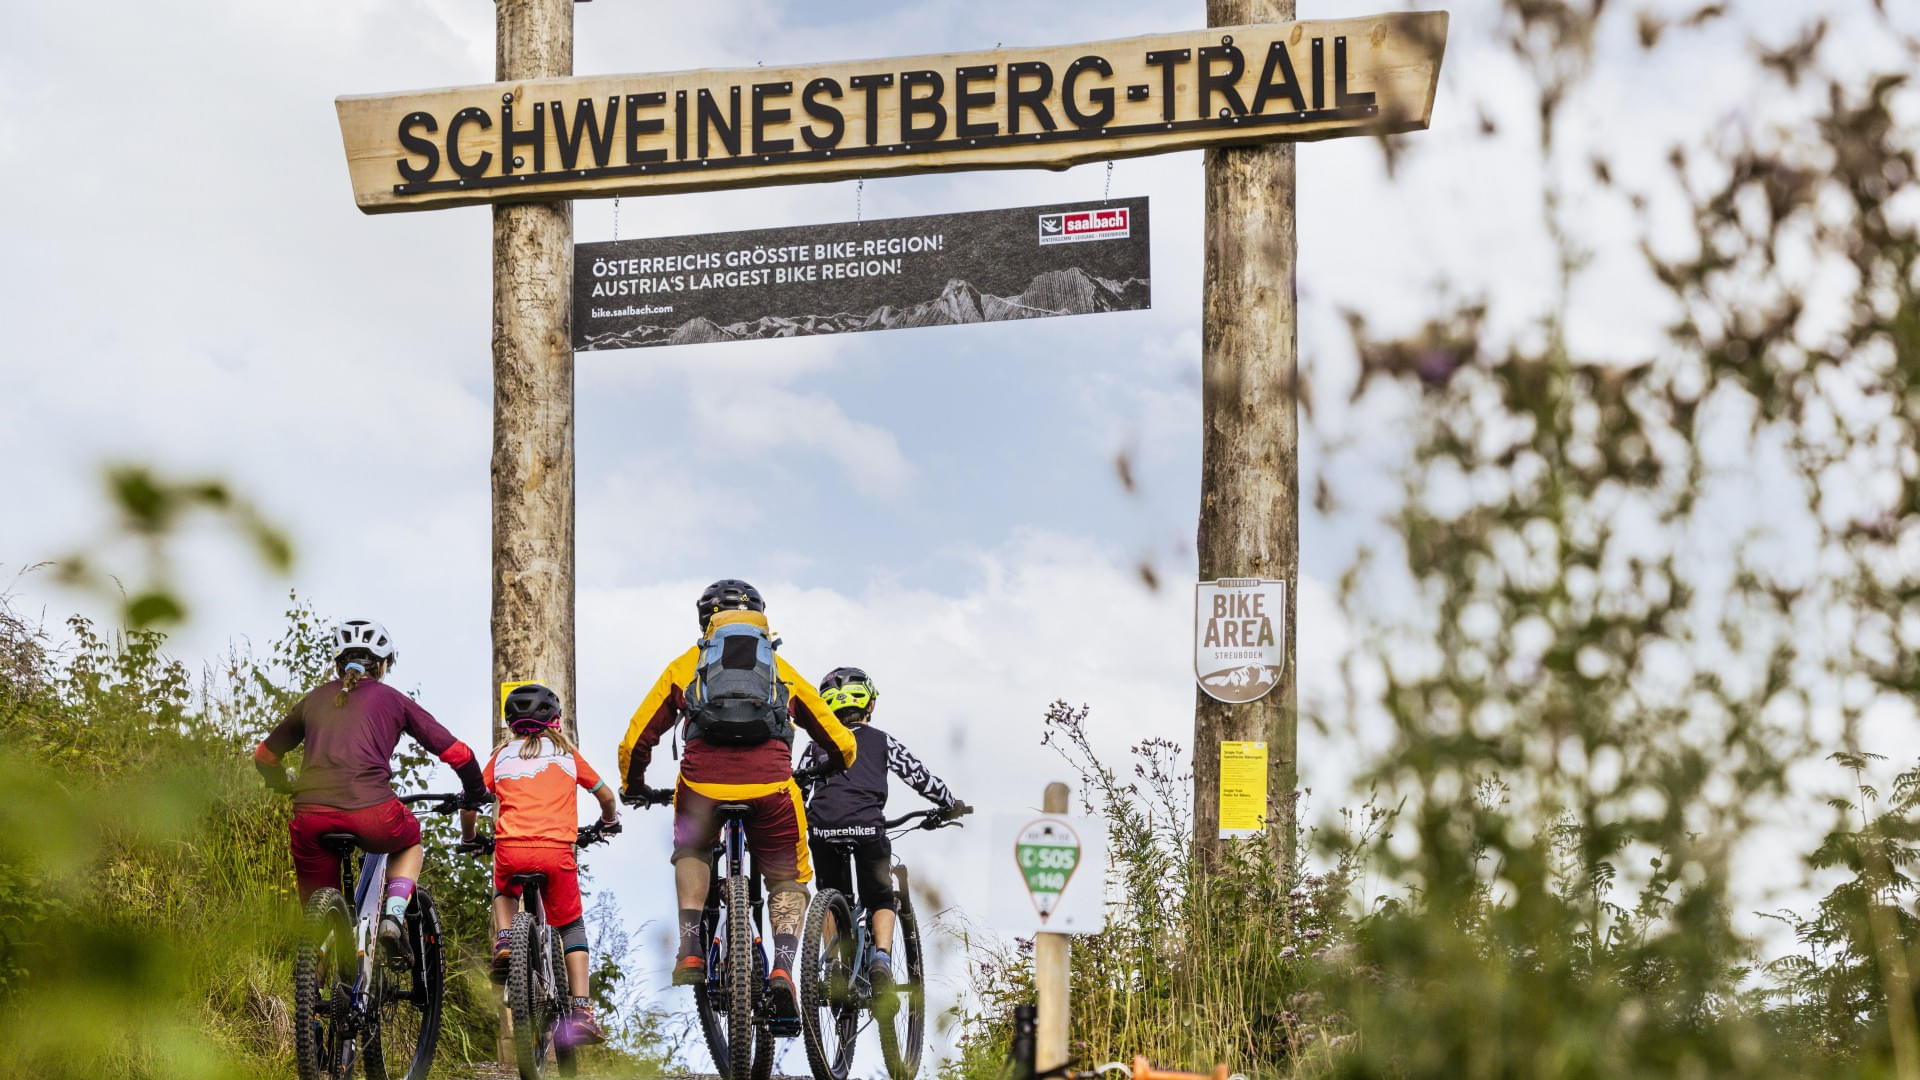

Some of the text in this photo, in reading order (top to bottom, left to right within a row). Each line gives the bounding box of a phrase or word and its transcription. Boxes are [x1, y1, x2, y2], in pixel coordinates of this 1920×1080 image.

[396, 36, 1376, 183] SCHWEINESTBERG-TRAIL
[1067, 210, 1124, 231] saalbach
[592, 234, 944, 277] ÖSTERREICHS GRÖSSTE BIKE-REGION!
[689, 268, 771, 290] LARGEST
[775, 265, 817, 284] BIKE
[822, 258, 902, 281] REGION!
[591, 304, 674, 319] bike.saalbach.com
[1213, 593, 1265, 618] BIKE
[1203, 616, 1275, 648] AREA
[1037, 847, 1075, 870] SOS
